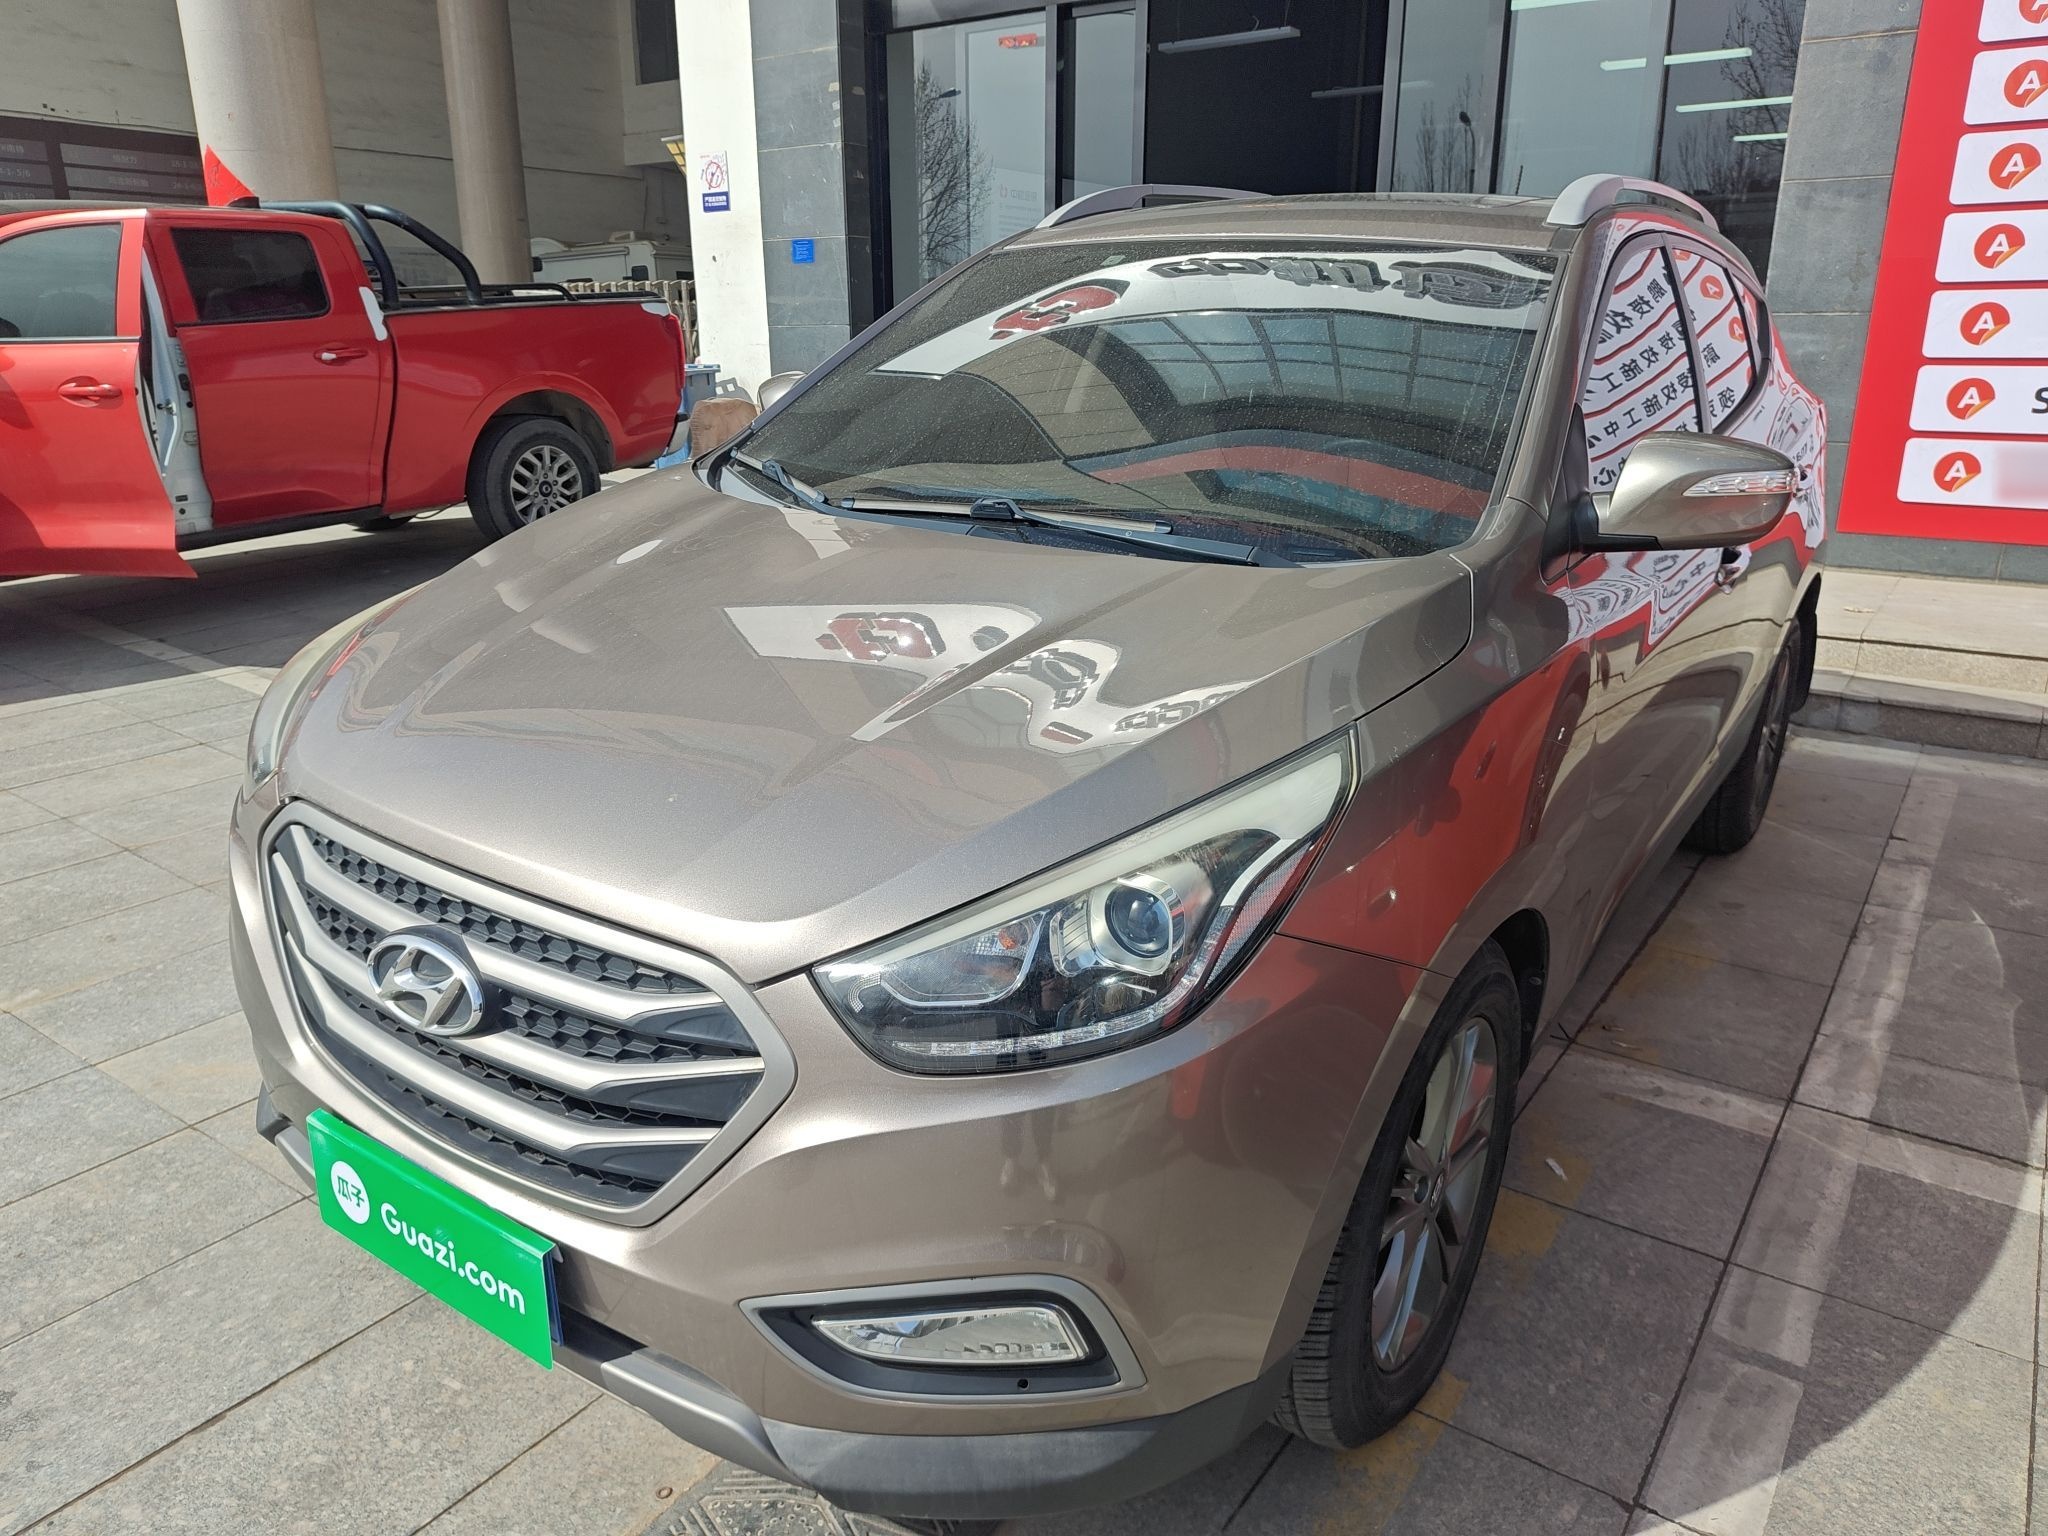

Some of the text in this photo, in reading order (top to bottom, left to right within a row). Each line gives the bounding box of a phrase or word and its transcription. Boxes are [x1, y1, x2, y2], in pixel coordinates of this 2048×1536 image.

[2016, 70, 2042, 96] A
[2000, 152, 2026, 178] A
[1985, 232, 2010, 257] A
[1971, 311, 1997, 334] A
[1957, 386, 1982, 409] A
[1944, 459, 1968, 482] A
[336, 1174, 365, 1209] 瓜子
[380, 1202, 526, 1316] Guazi.com
